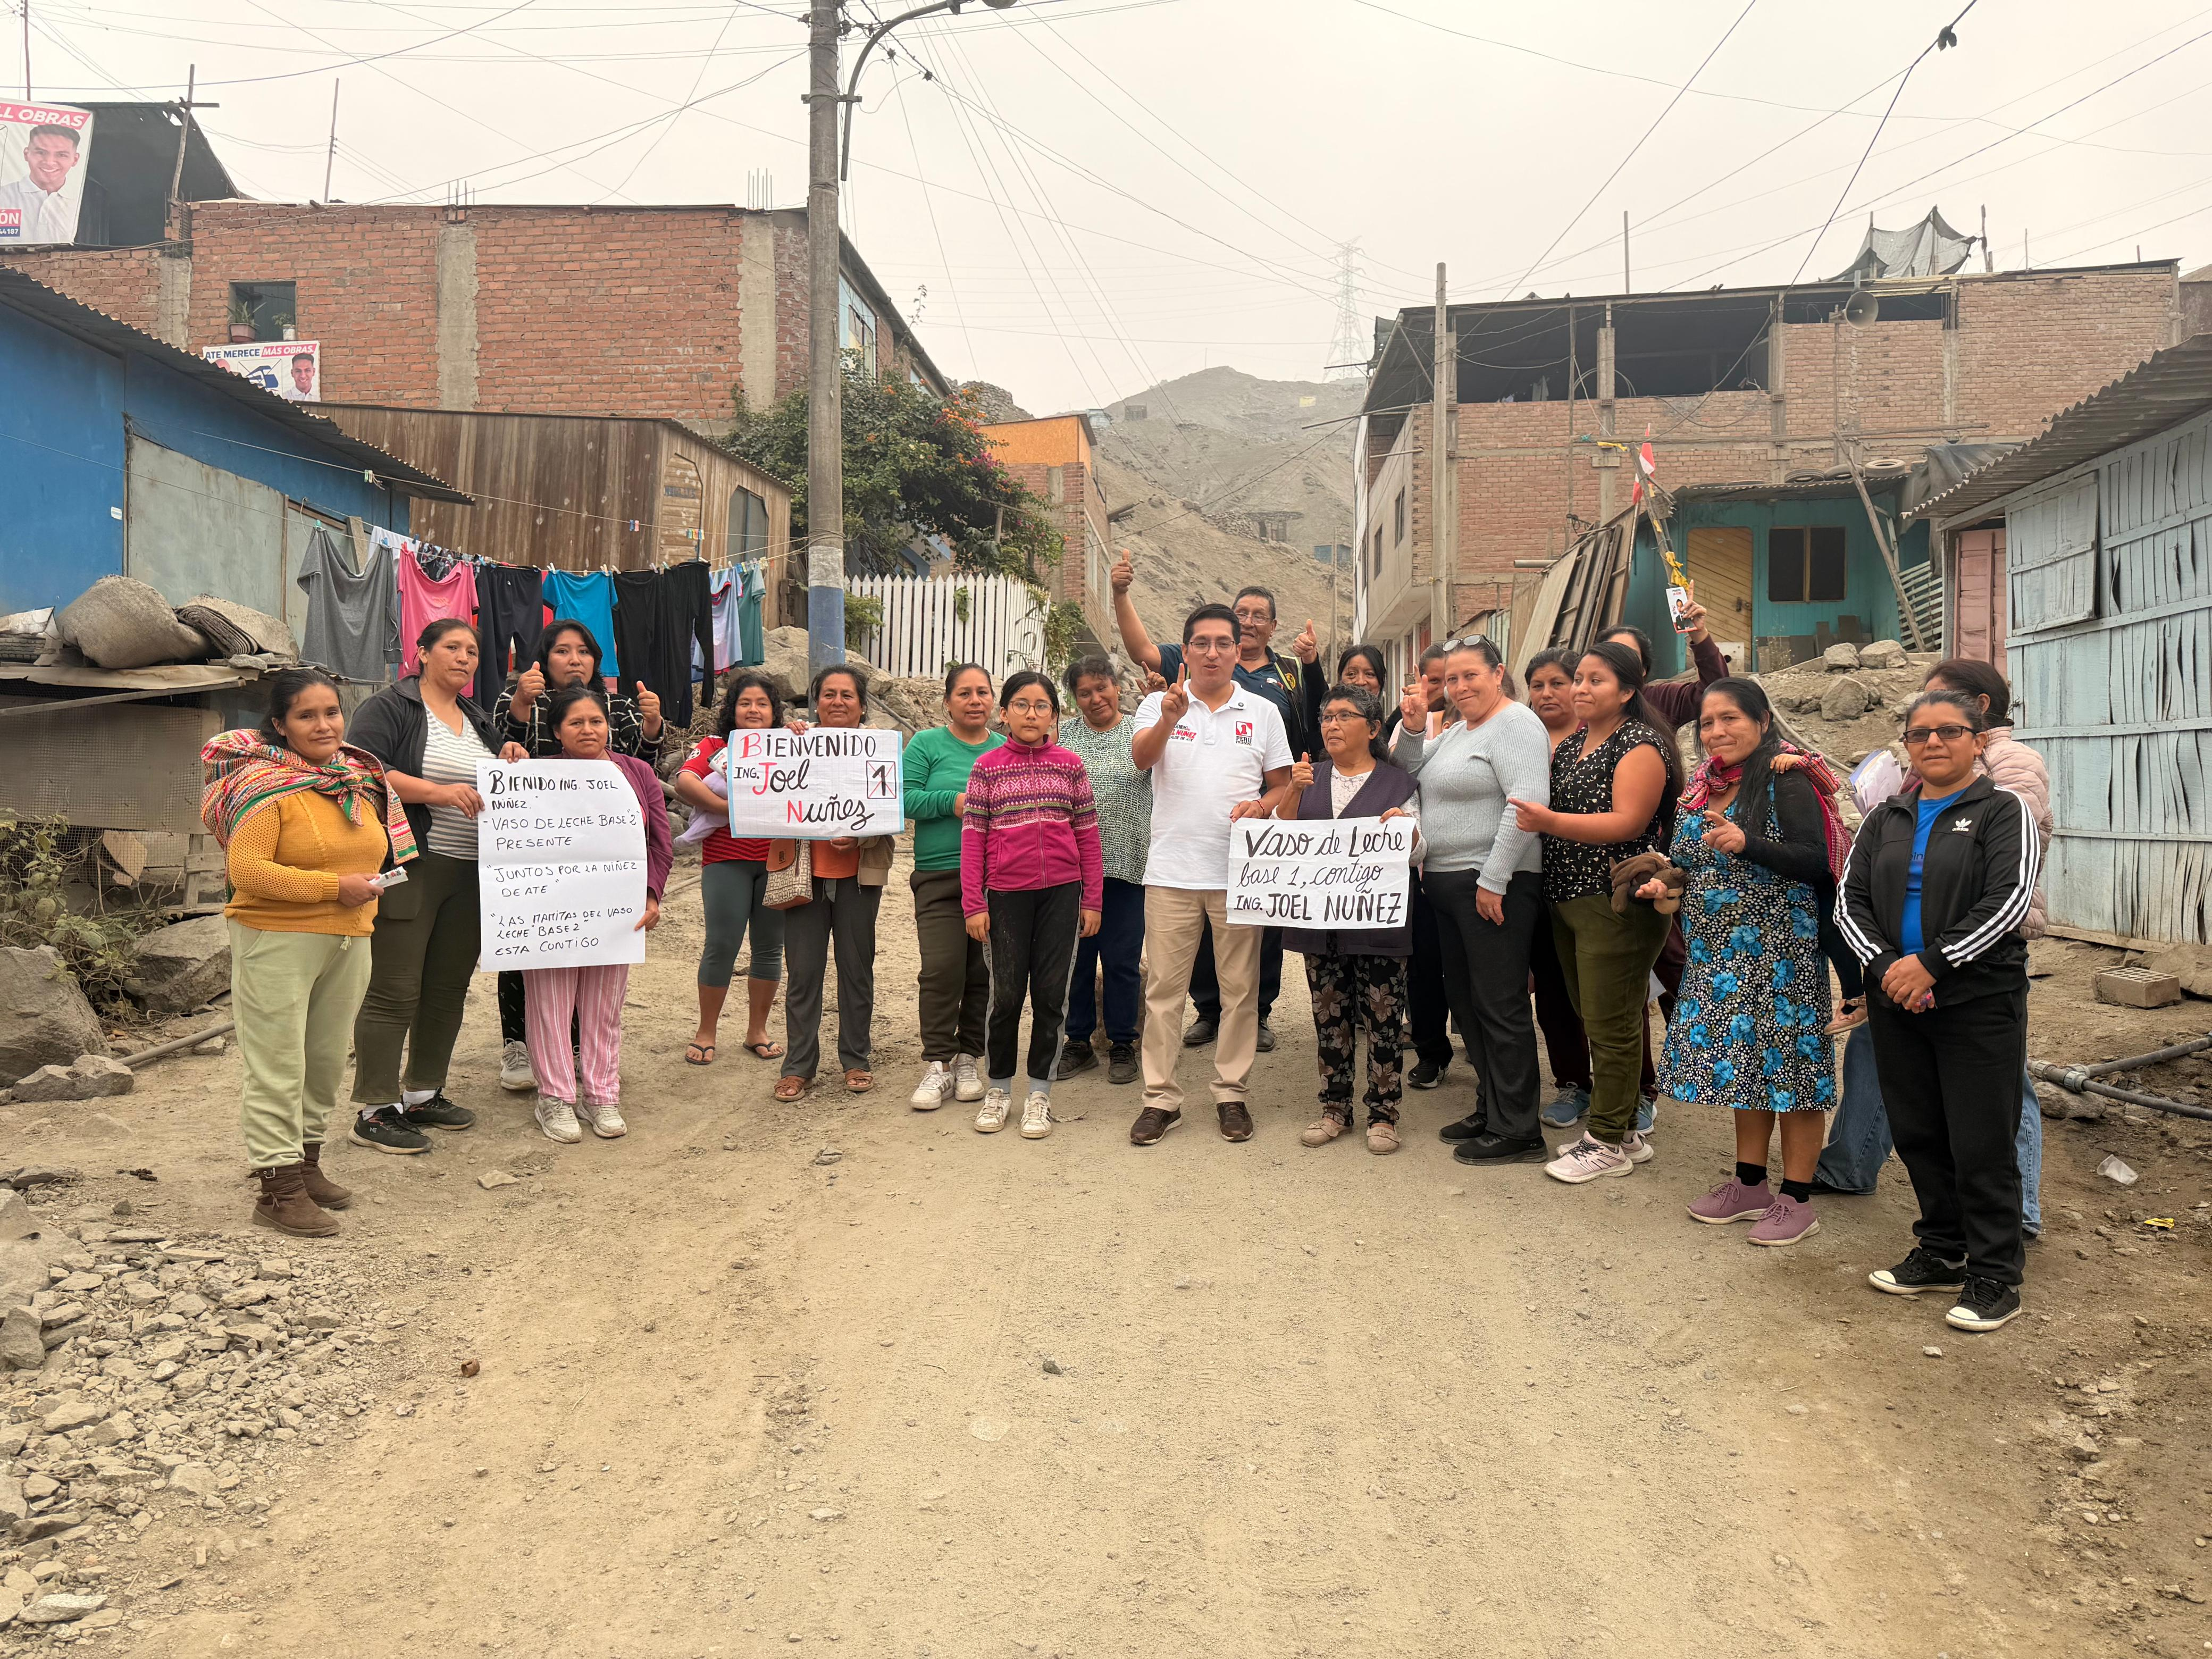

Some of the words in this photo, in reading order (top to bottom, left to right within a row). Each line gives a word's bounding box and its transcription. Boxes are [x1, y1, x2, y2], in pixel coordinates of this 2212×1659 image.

[18, 108, 85, 127] OBRAS
[223, 349, 260, 358] MERECE
[263, 346, 282, 356] MÁS
[283, 345, 314, 355] OBRAS.
[1241, 724, 1247, 735] 1
[739, 732, 876, 759] BIENVENIDO
[560, 778, 580, 791] ING.
[586, 779, 618, 790] JOEL
[734, 766, 760, 780] ING.
[752, 759, 810, 795] Joel
[872, 765, 886, 796] 1
[787, 794, 875, 831] Nuñez
[534, 818, 555, 829] DE
[558, 816, 594, 828] LECHE
[598, 814, 626, 826] BASE
[496, 836, 572, 851] PRESENTE
[1245, 825, 1314, 858] Vaso
[1314, 828, 1342, 856] de
[1348, 824, 1405, 857] Leche
[558, 865, 581, 875] POR
[604, 860, 638, 873] NIÑEZ
[1236, 862, 1279, 887] base
[1309, 858, 1384, 892] contigo
[502, 887, 520, 897] DE
[583, 910, 601, 922] DEL
[608, 907, 633, 918] VASO
[1234, 895, 1263, 911] ING.
[1266, 893, 1312, 920] JOEL
[497, 929, 529, 939] LECHE
[538, 925, 569, 936] BASE
[495, 945, 530, 956] ESTA
[540, 937, 599, 952] CONTIGO
